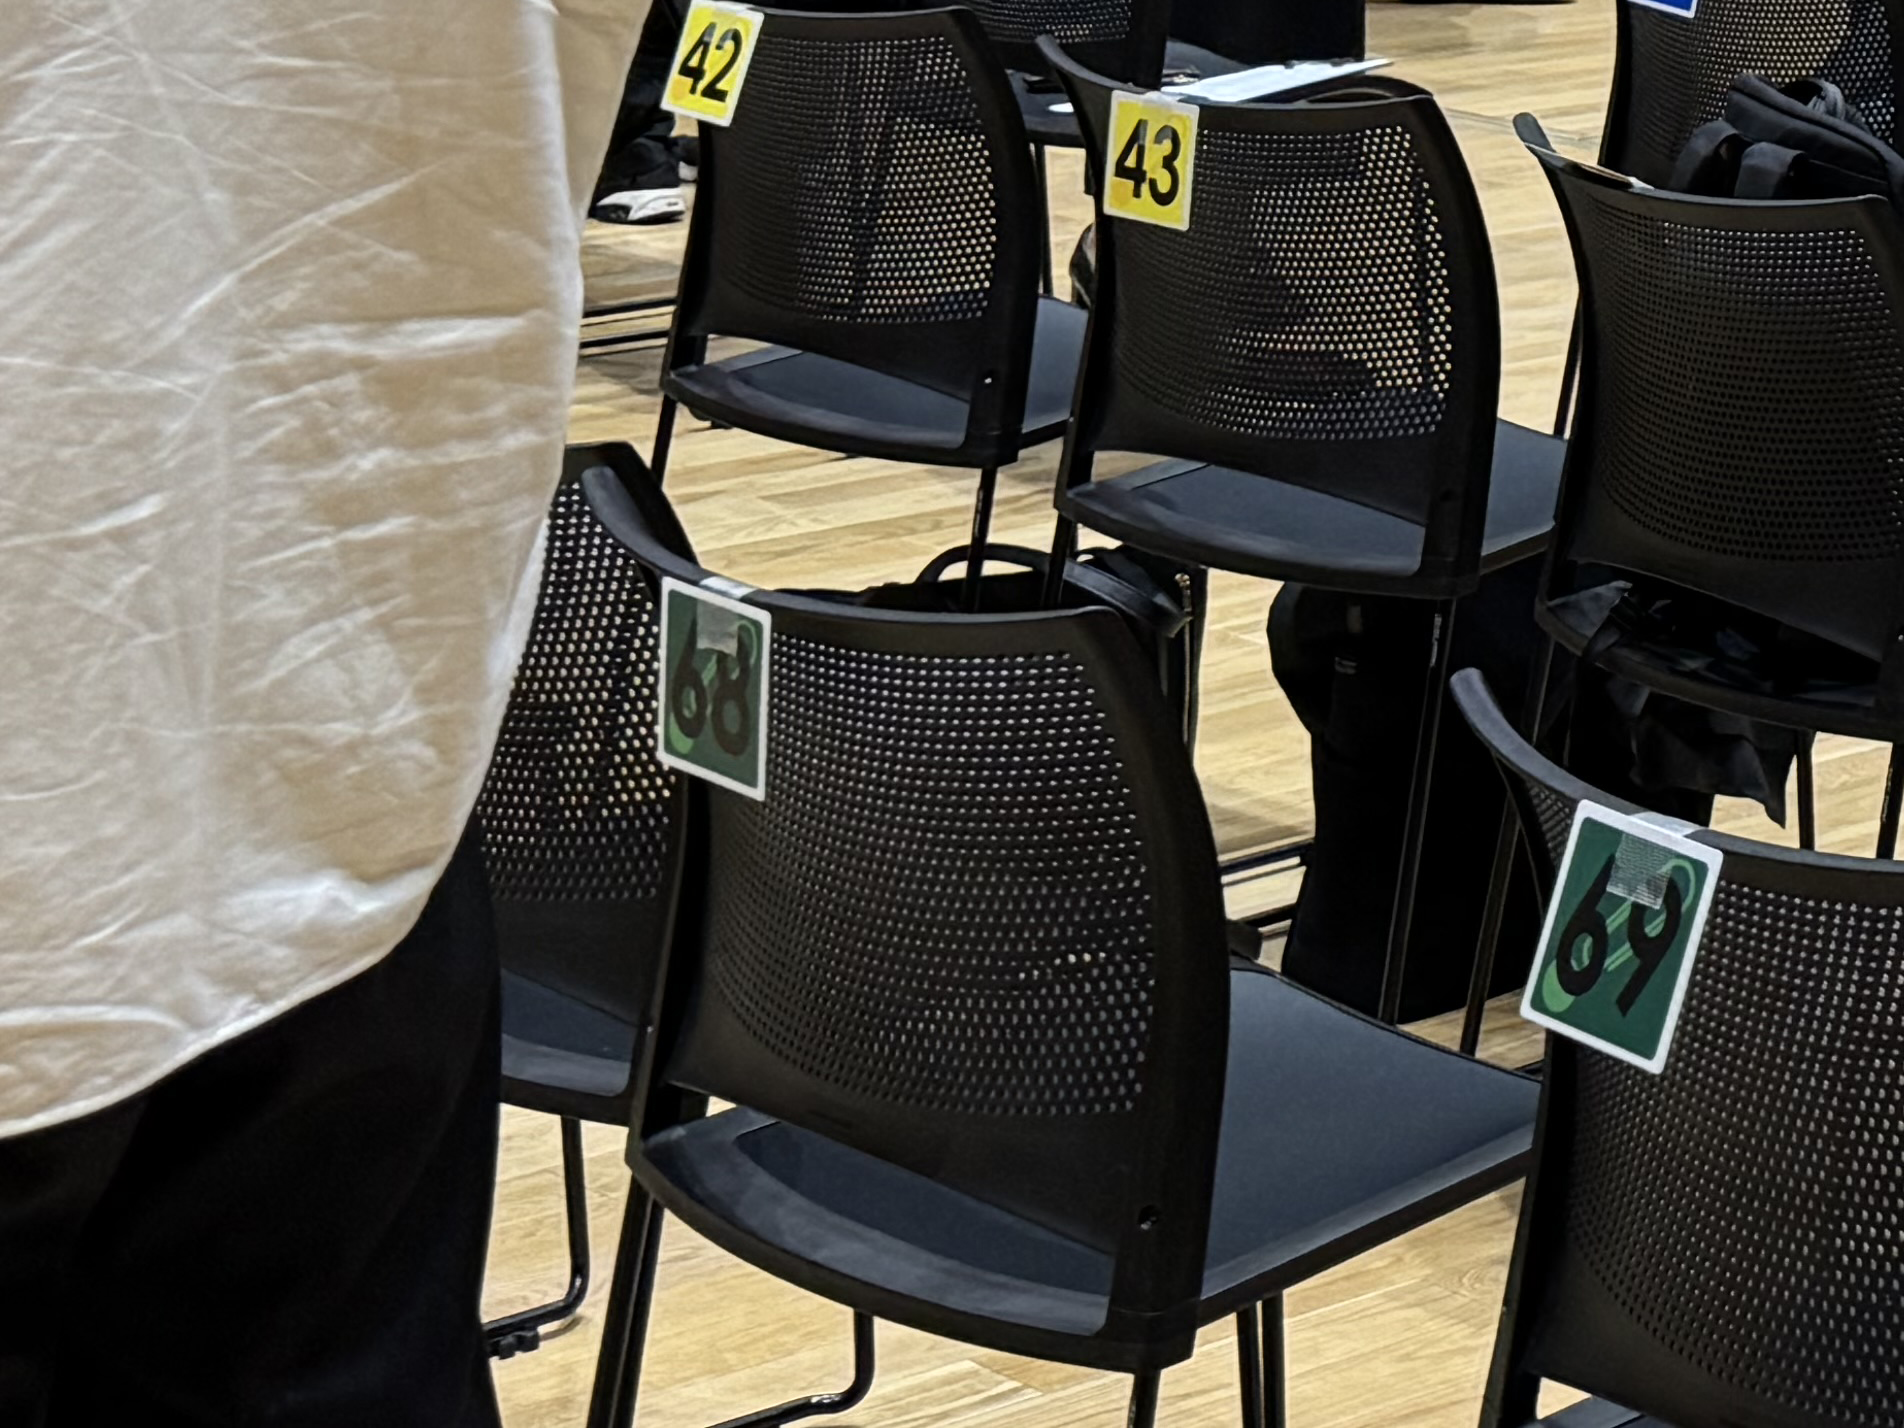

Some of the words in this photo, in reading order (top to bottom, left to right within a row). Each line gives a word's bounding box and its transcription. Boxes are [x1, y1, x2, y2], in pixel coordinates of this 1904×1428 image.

[678, 21, 744, 104] 42
[1113, 118, 1182, 207] 43
[672, 616, 751, 757] 68
[1556, 853, 1682, 1018] 69
